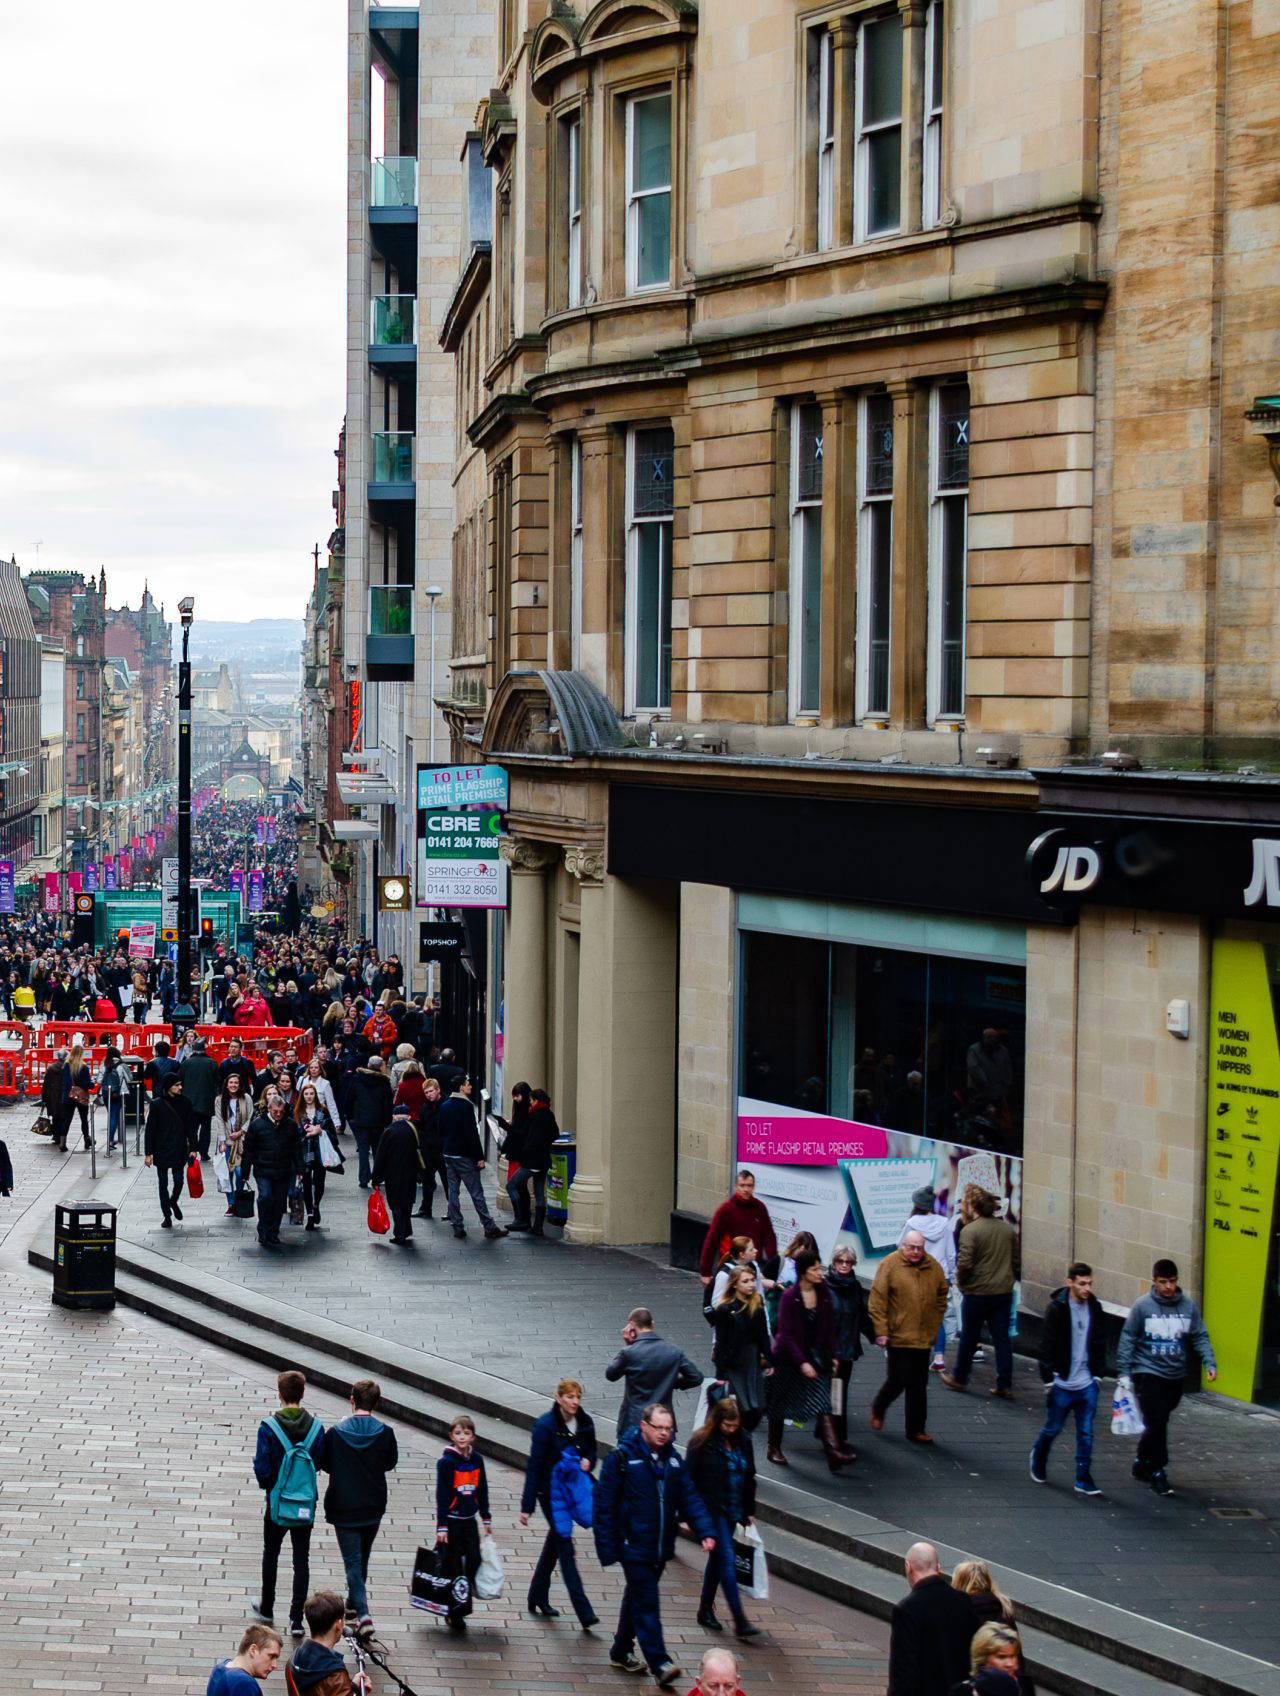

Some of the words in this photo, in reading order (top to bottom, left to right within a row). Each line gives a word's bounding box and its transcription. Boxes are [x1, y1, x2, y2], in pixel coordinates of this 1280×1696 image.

[432, 772, 451, 784] TO
[456, 768, 482, 781] LET
[420, 783, 453, 796] PRIME
[455, 777, 503, 794] FLAGSHIP
[420, 794, 453, 806] RETAIL
[455, 788, 506, 802] PREMISES
[427, 816, 480, 832] CBRE
[427, 836, 452, 848] 0141
[454, 836, 472, 848] 204
[474, 837, 499, 848] 7666
[427, 866, 498, 877] SPRINGFORD
[1040, 846, 1101, 893] JD
[427, 884, 450, 894] 0141
[453, 884, 471, 895] 332
[473, 884, 498, 895] 8050
[1218, 1011, 1237, 1024] MEN
[1217, 1027, 1250, 1042] WOMEN
[1216, 1044, 1247, 1058] JUNIOR
[1216, 1059, 1252, 1075] NIPPERS
[1226, 1083, 1241, 1092] KING
[1248, 1086, 1279, 1098] TRAINERS
[746, 1122, 757, 1136] TO
[760, 1122, 773, 1136] LET
[746, 1141, 766, 1155] PRIME
[768, 1142, 801, 1155] FLAGSHIP
[803, 1142, 827, 1156] RETAIL
[828, 1142, 864, 1156] PREMISES
[1213, 1218, 1231, 1232] FILA
